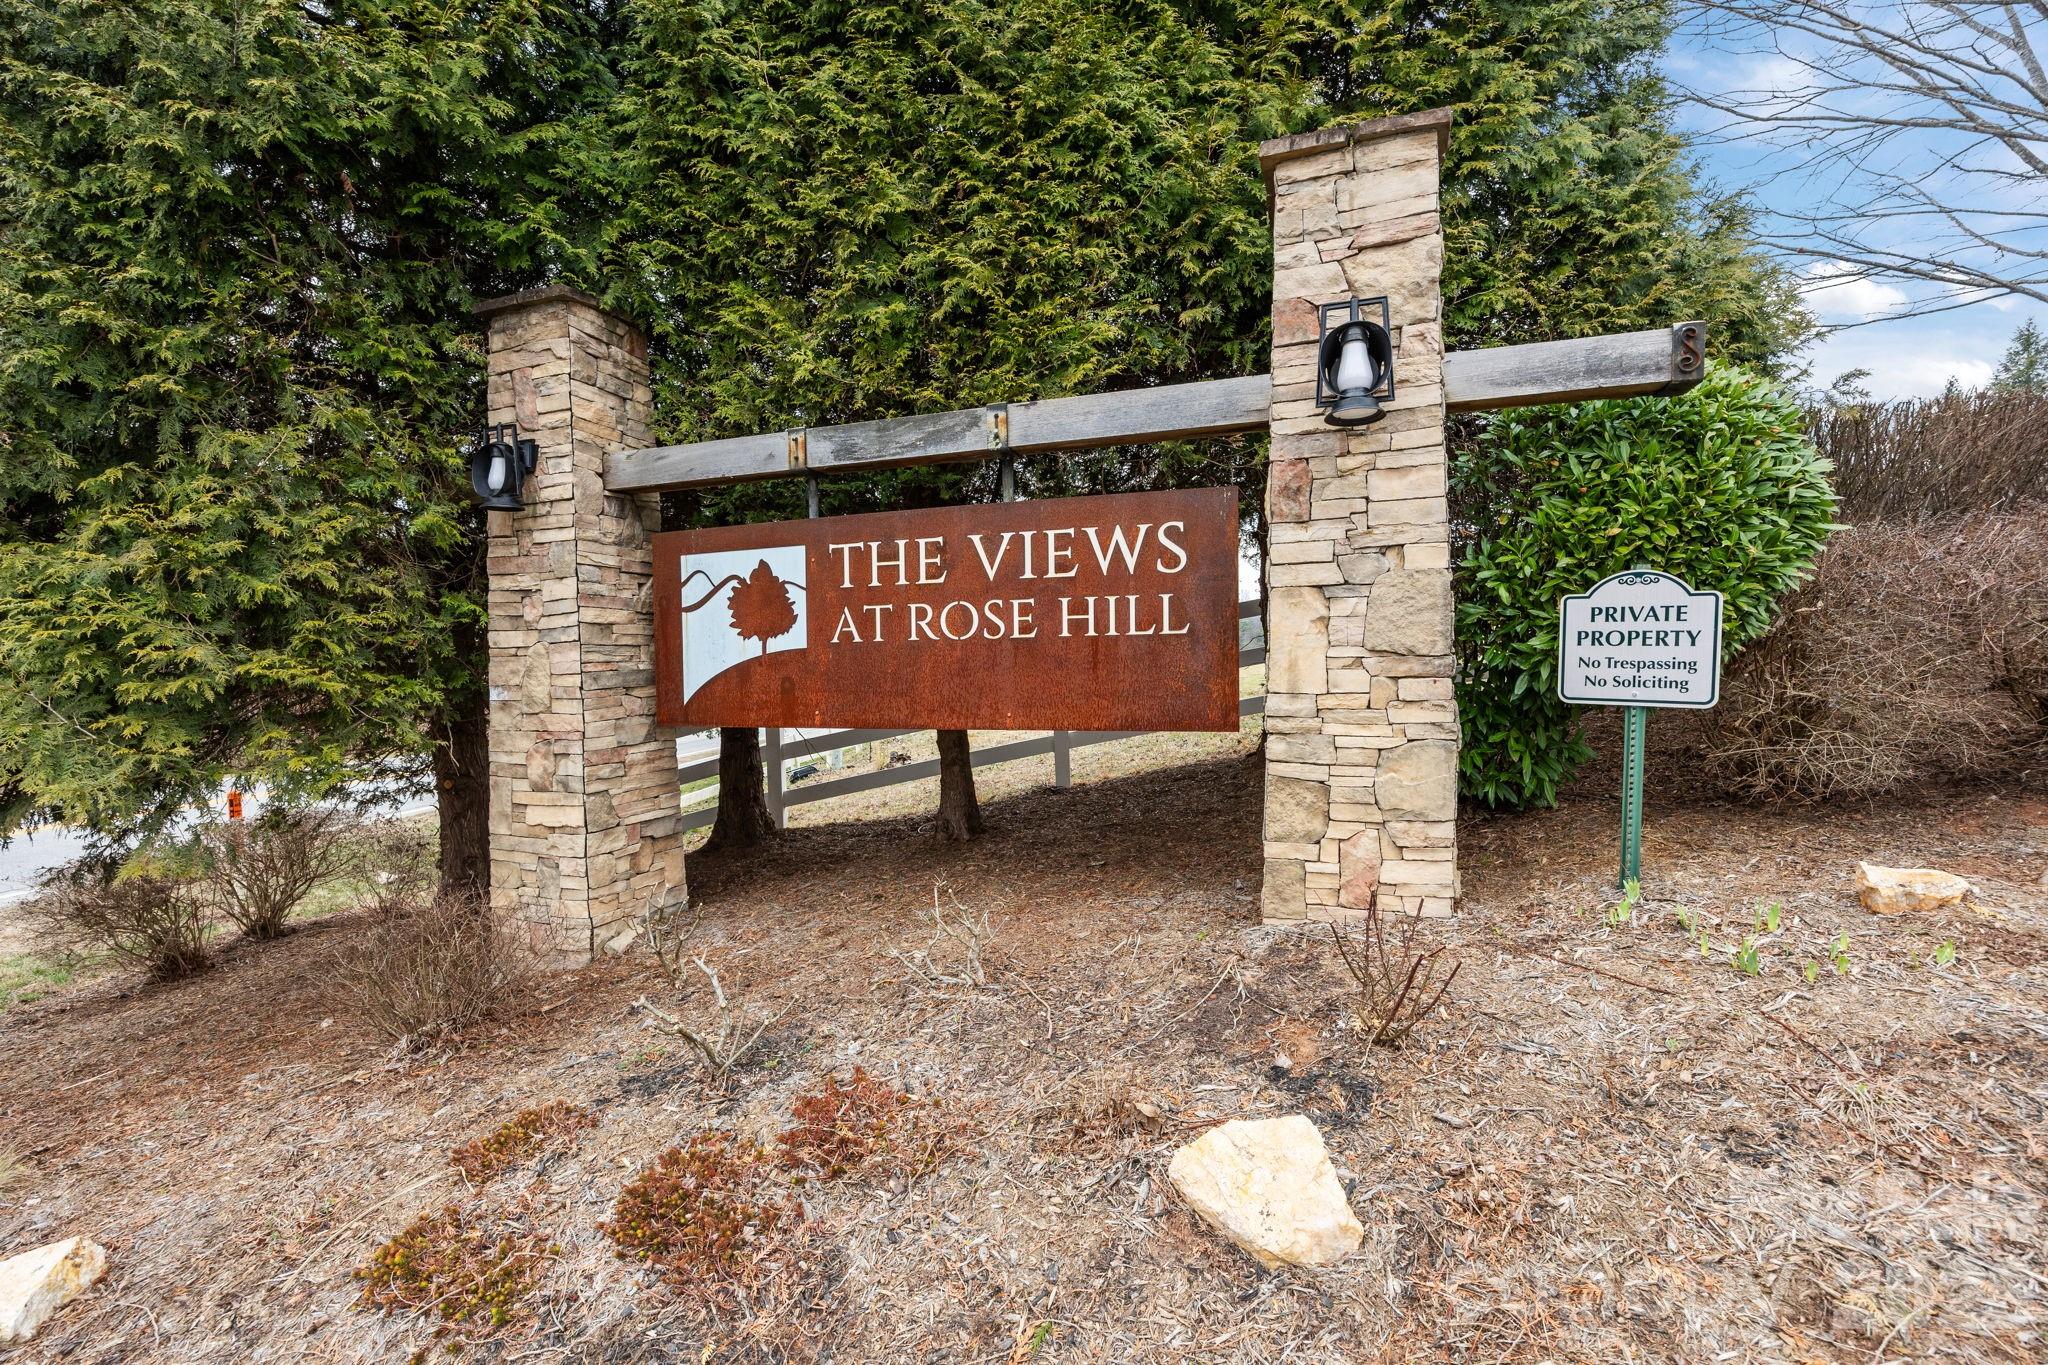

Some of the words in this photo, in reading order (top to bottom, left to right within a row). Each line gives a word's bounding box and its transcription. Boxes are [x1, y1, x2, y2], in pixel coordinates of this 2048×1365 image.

[828, 532, 948, 589] THE
[966, 520, 1188, 583] VIEWS
[829, 603, 893, 643] AT
[907, 598, 1038, 642] ROSE
[1057, 593, 1191, 637] HILL
[1590, 604, 1689, 623] PRIVATE
[1577, 630, 1702, 647] PROPERTY
[1578, 656, 1602, 669] No
[1605, 656, 1698, 675] Trespassing
[1584, 675, 1608, 688] No
[1612, 675, 1691, 694] Soliciting
